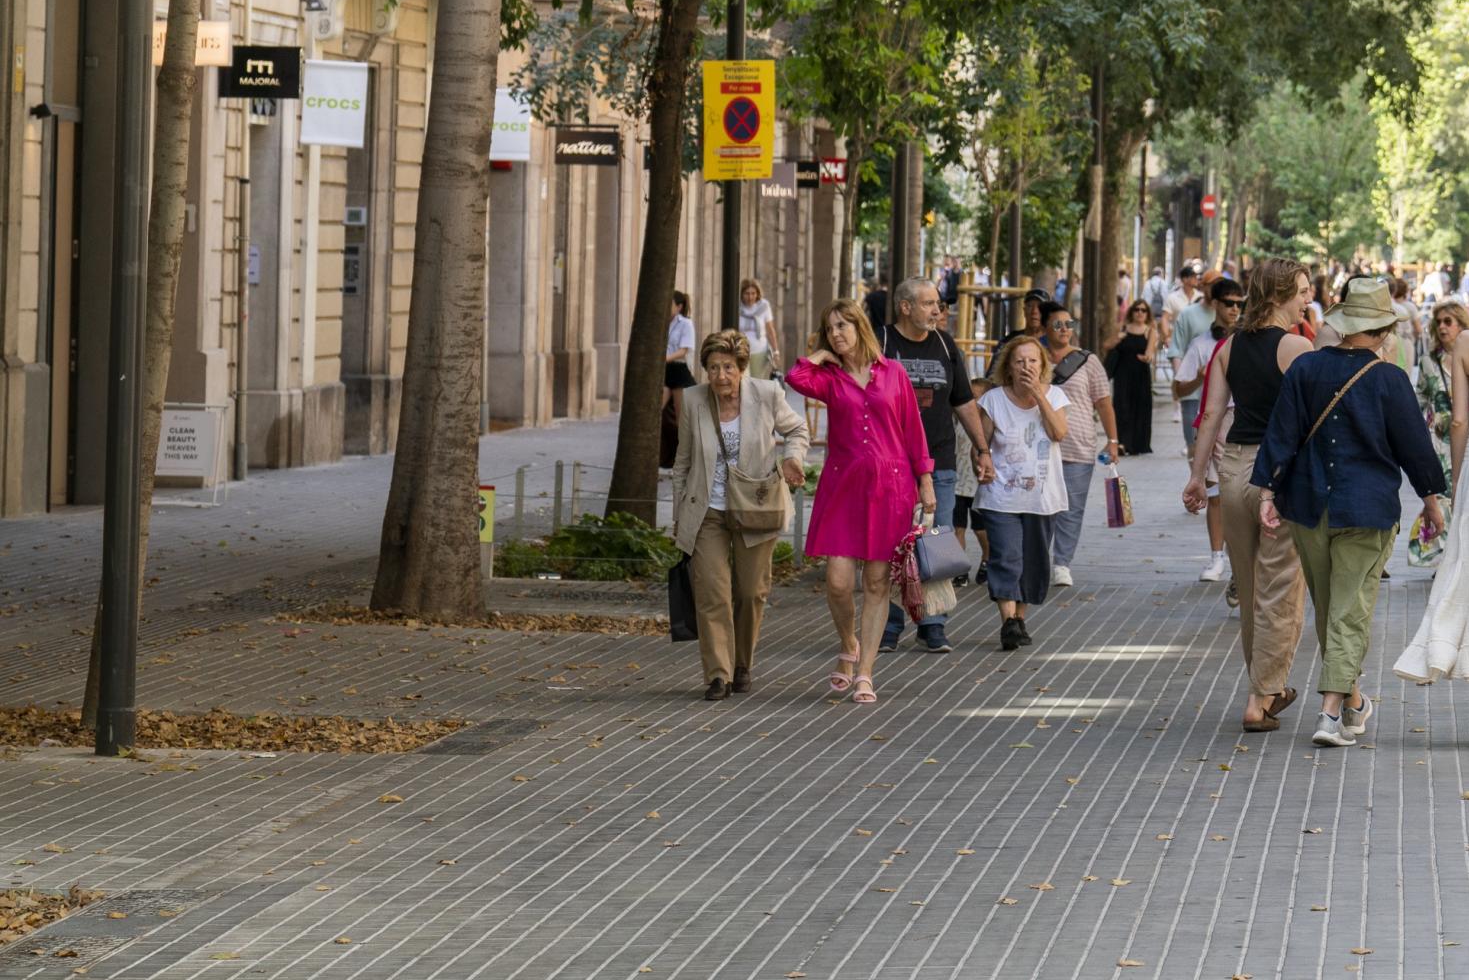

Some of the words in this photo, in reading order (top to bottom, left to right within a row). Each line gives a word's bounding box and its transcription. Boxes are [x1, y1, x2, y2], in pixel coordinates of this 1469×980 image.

[239, 77, 281, 87] MAJORAL
[305, 95, 361, 110] crocs
[491, 121, 528, 132] rocs
